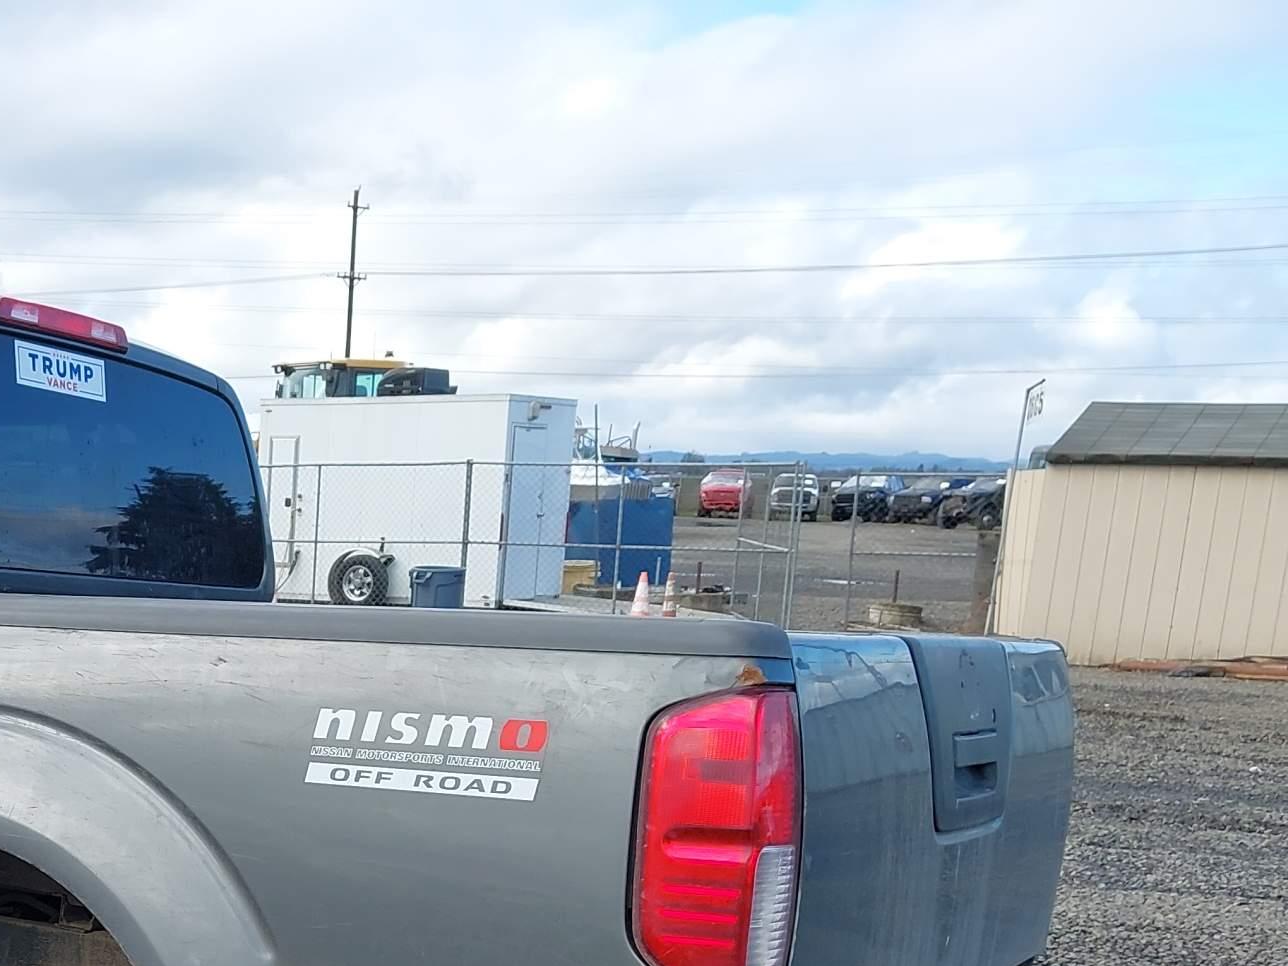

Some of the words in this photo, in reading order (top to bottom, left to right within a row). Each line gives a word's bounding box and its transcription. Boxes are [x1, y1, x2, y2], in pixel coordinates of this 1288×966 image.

[28, 352, 94, 384] TRUMP
[47, 376, 79, 393] VANCE
[312, 707, 548, 752] nismo
[310, 746, 353, 758] NISSAN
[355, 749, 444, 765] MOTORSPORTS
[446, 755, 541, 772] INTERNATIONAL
[329, 767, 394, 785] OFF
[413, 774, 512, 795] ROAD
